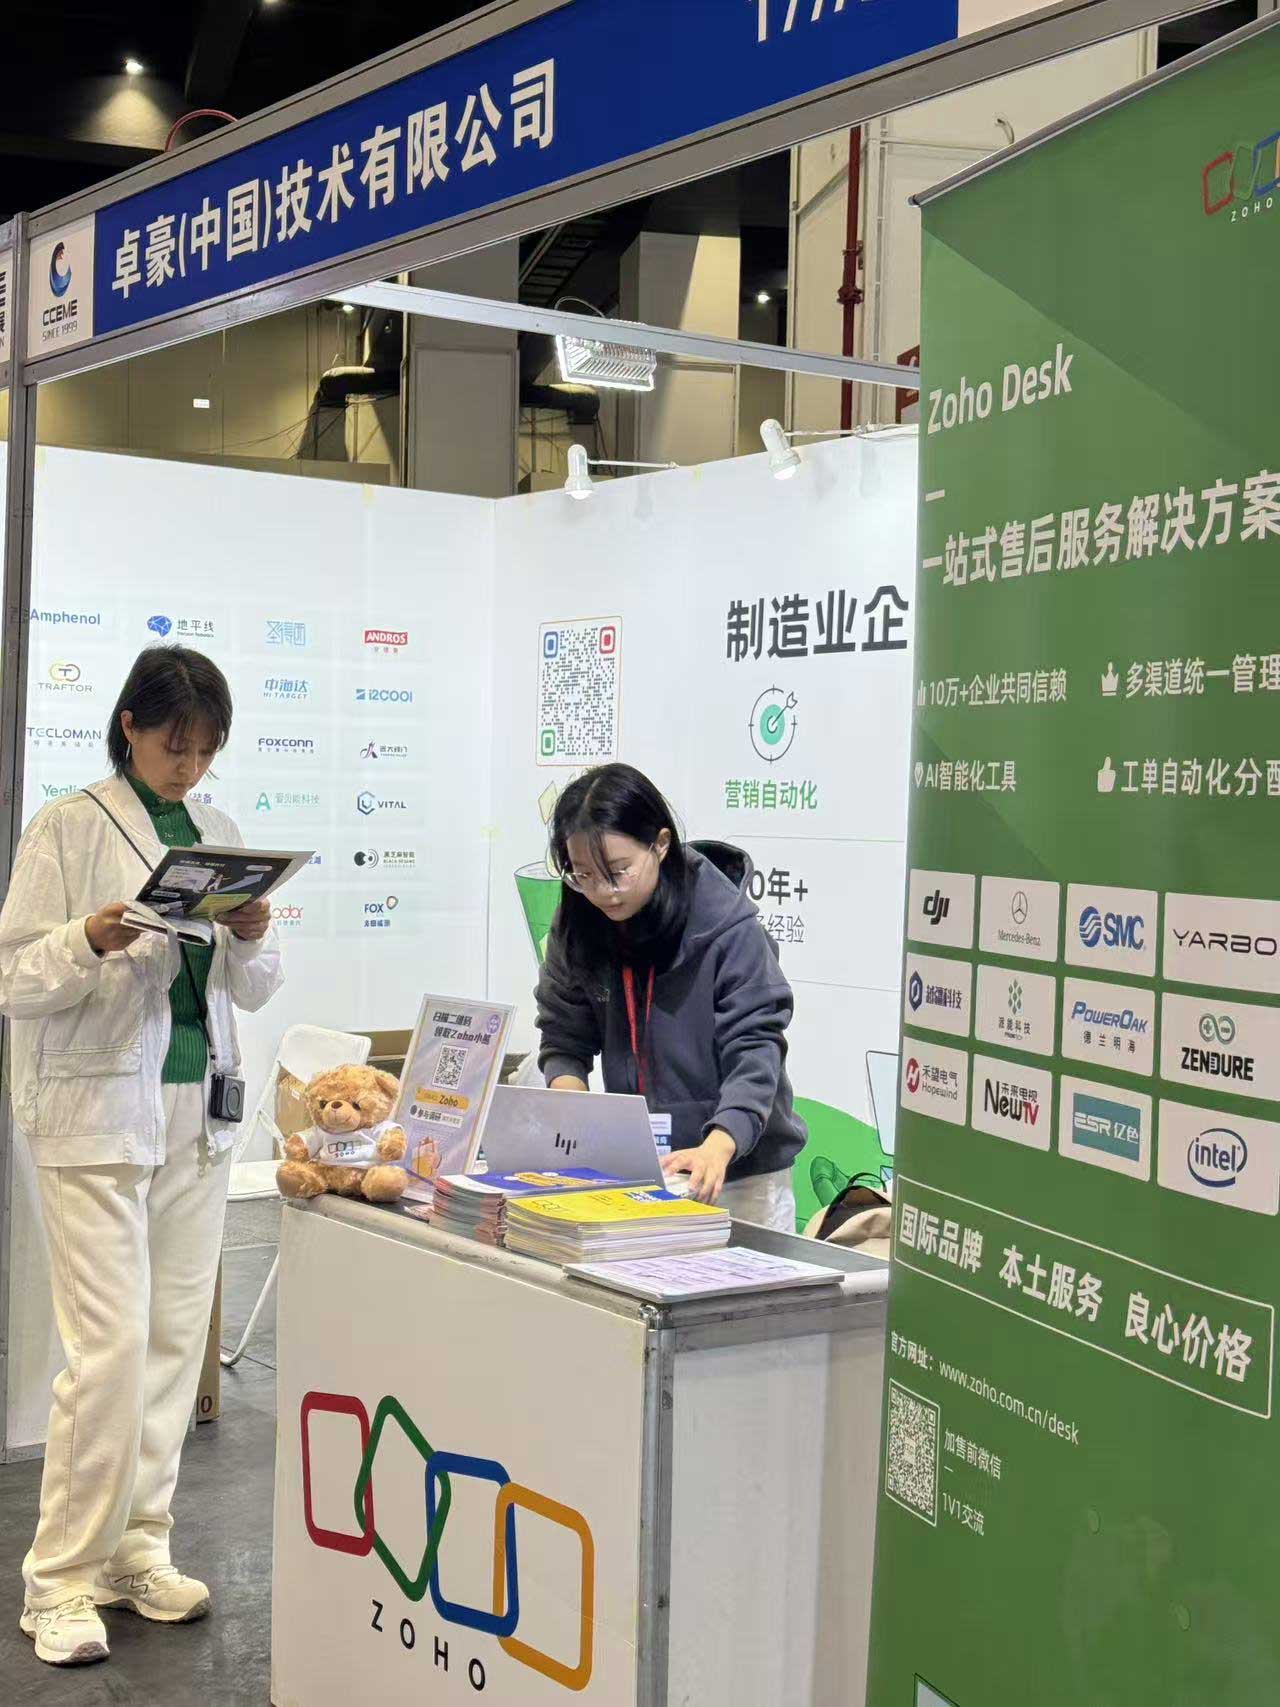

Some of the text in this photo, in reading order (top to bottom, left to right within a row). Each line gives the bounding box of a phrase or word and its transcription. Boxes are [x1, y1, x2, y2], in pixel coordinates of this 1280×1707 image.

[112, 58, 555, 299] 卓豪(中国)技术有限公司
[1231, 197, 1273, 222] ZOHO
[42, 299, 78, 326] CCEME
[42, 320, 78, 342] SINCE 1999
[927, 342, 1074, 435] Zoho Desk
[922, 469, 1280, 586] 一站式售后服务解决方案
[30, 608, 101, 625] Amphenol
[177, 618, 214, 632] 地平线
[726, 585, 909, 662] 制造业企
[366, 631, 407, 645] ANDROS
[38, 682, 93, 692] TRAFTOR
[264, 678, 309, 692] 中海达
[929, 667, 1067, 707] 10万+企业共同信赖
[1125, 653, 1280, 698] 多渠道统一管理
[925, 759, 1017, 793] AI智能化工具
[377, 801, 407, 809] VITAL
[725, 778, 818, 810] 营销自动化
[364, 903, 384, 913] FOX
[998, 929, 1041, 947] Mercedes-Benz
[1104, 912, 1145, 951] SMC
[1173, 929, 1277, 956] YARBO
[922, 1065, 959, 1087] 禾望电气
[1181, 1047, 1255, 1082] ZENDURE
[921, 1082, 958, 1100] Hopewind
[1001, 1082, 1038, 1103] 未来电视
[1073, 1111, 1139, 1145] ESR 亿色
[1195, 1137, 1236, 1172] intel
[899, 1202, 1252, 1383] 国际品牌 本土服务 良心价格
[939, 1361, 1079, 1445] www.zoho.com.cn/desk
[944, 1428, 1002, 1480] 加售前微信
[371, 1599, 486, 1692] ZOHO
